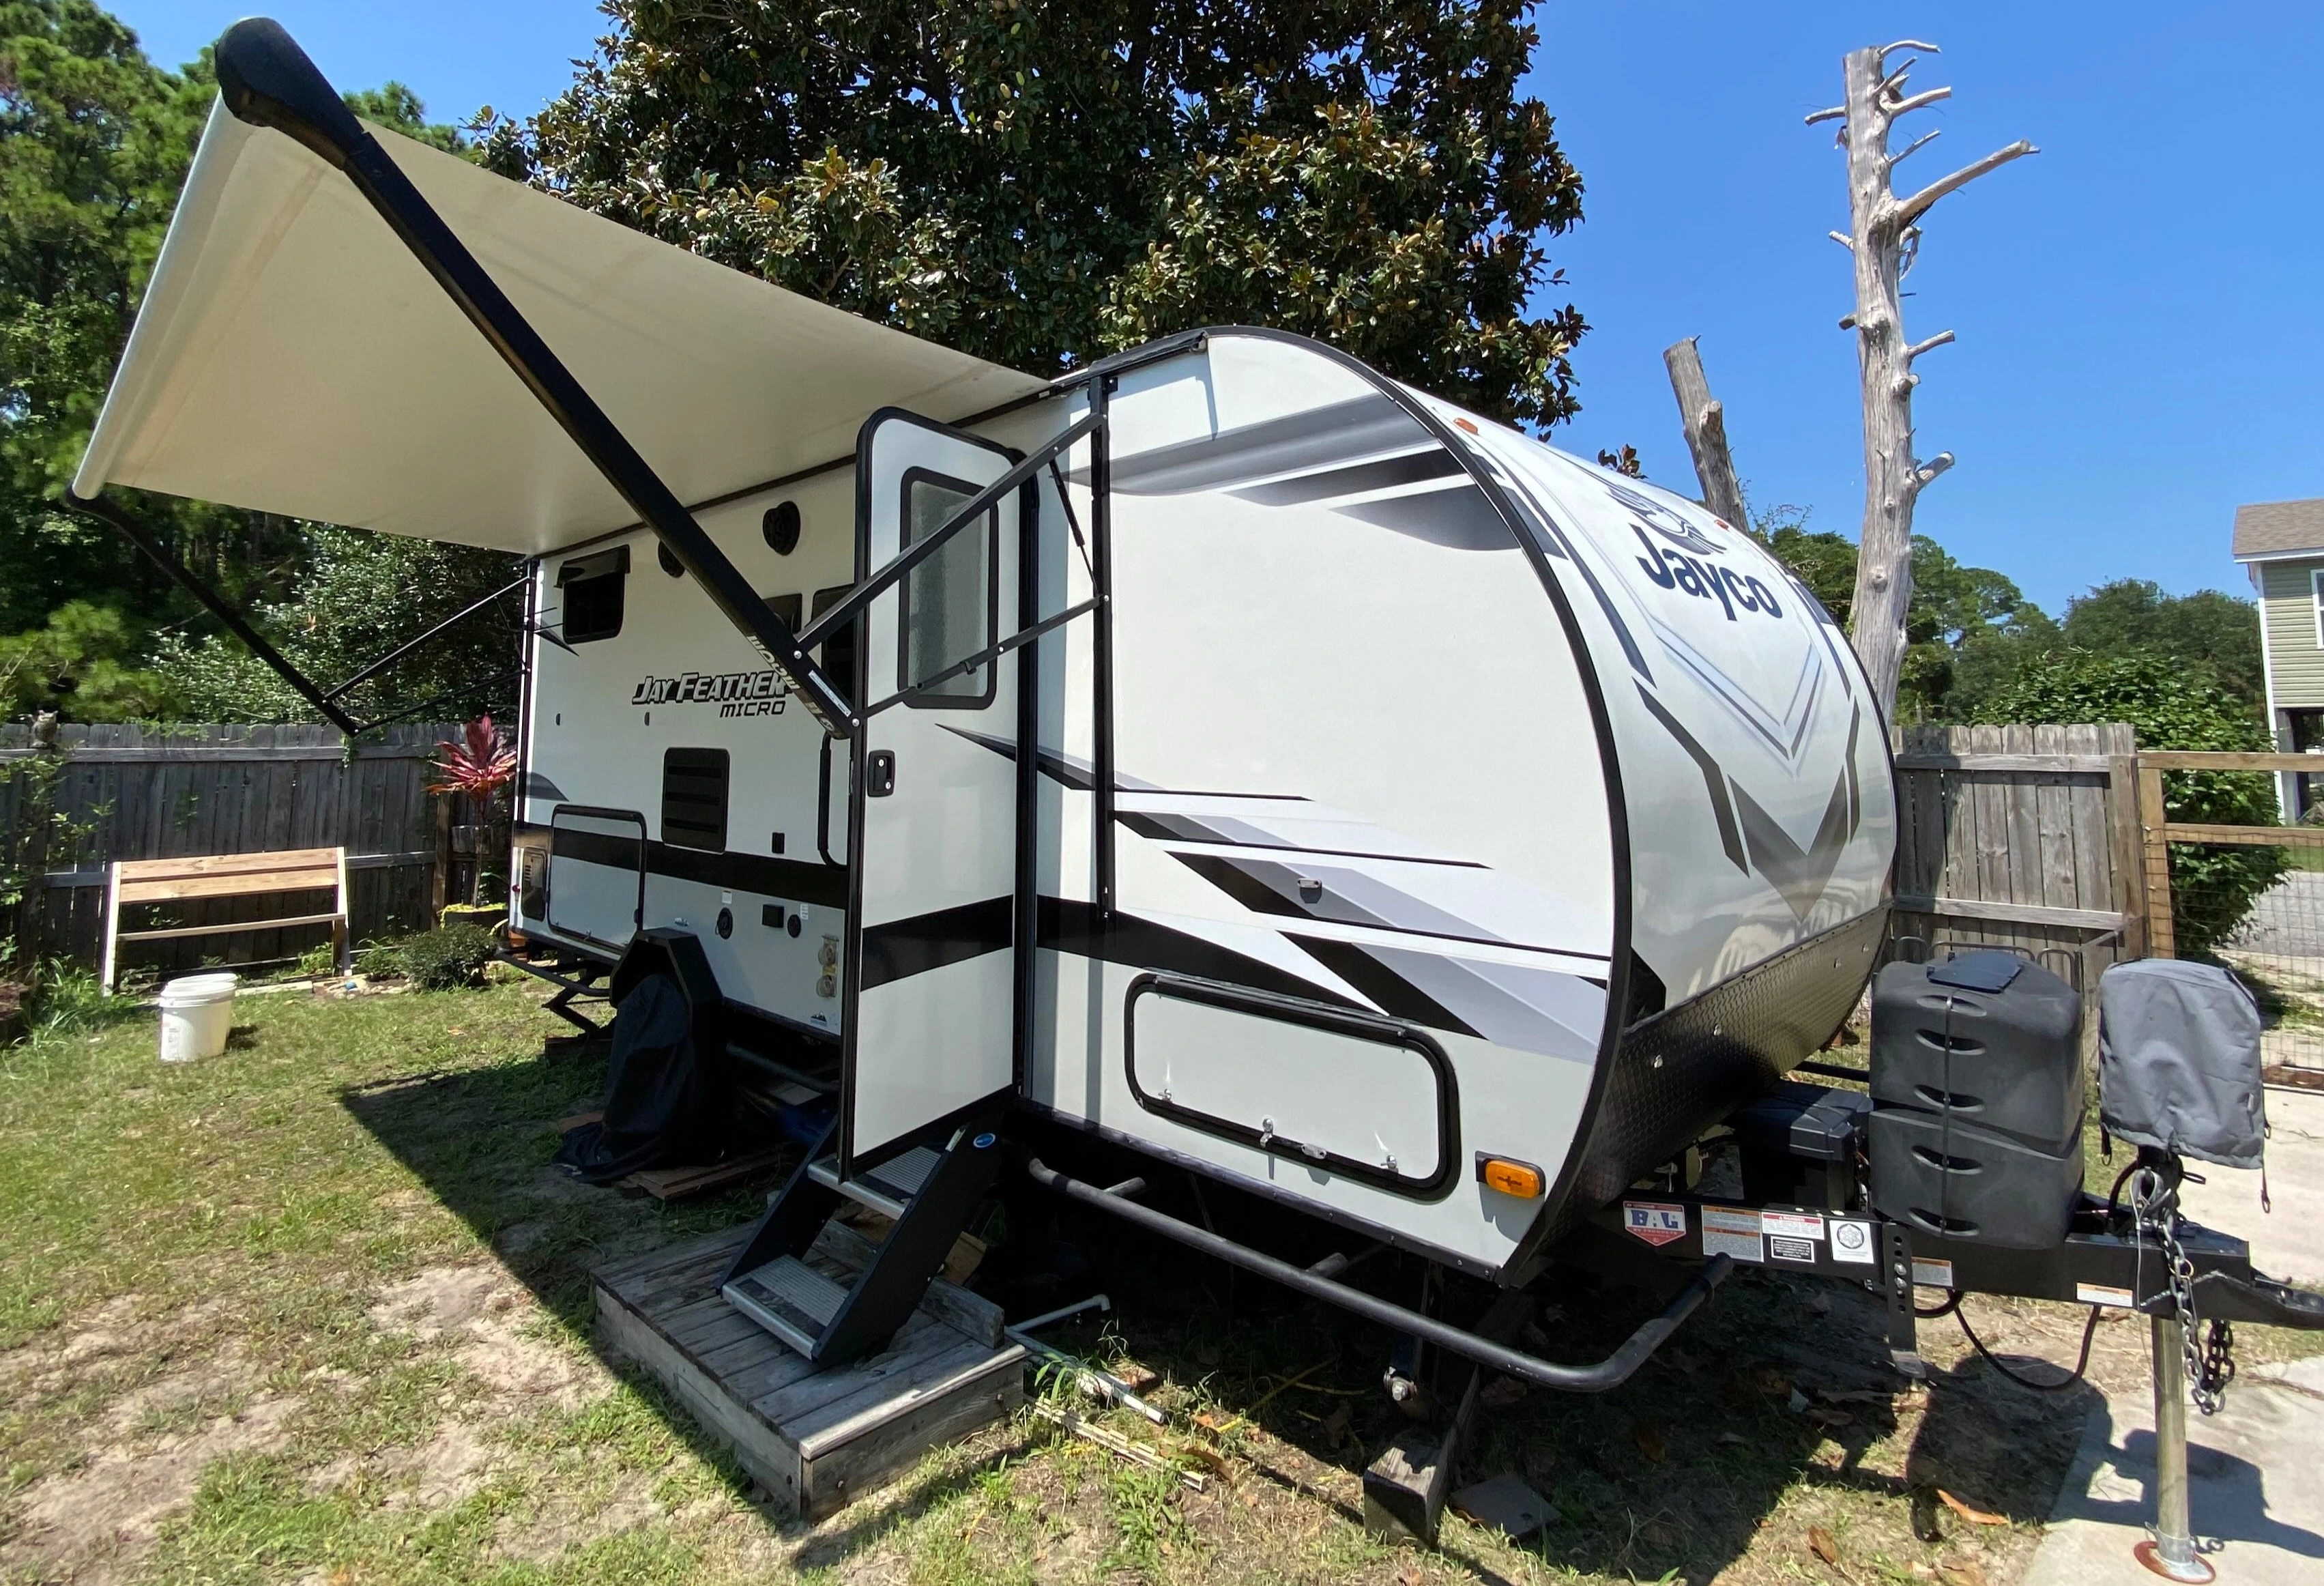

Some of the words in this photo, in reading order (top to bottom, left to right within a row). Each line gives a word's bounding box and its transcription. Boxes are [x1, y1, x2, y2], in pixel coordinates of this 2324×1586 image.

[1627, 522, 1783, 622] Jayco
[632, 675, 676, 705] JAY
[719, 700, 787, 718] MICRO
[1631, 1209, 1679, 1229] BAL
